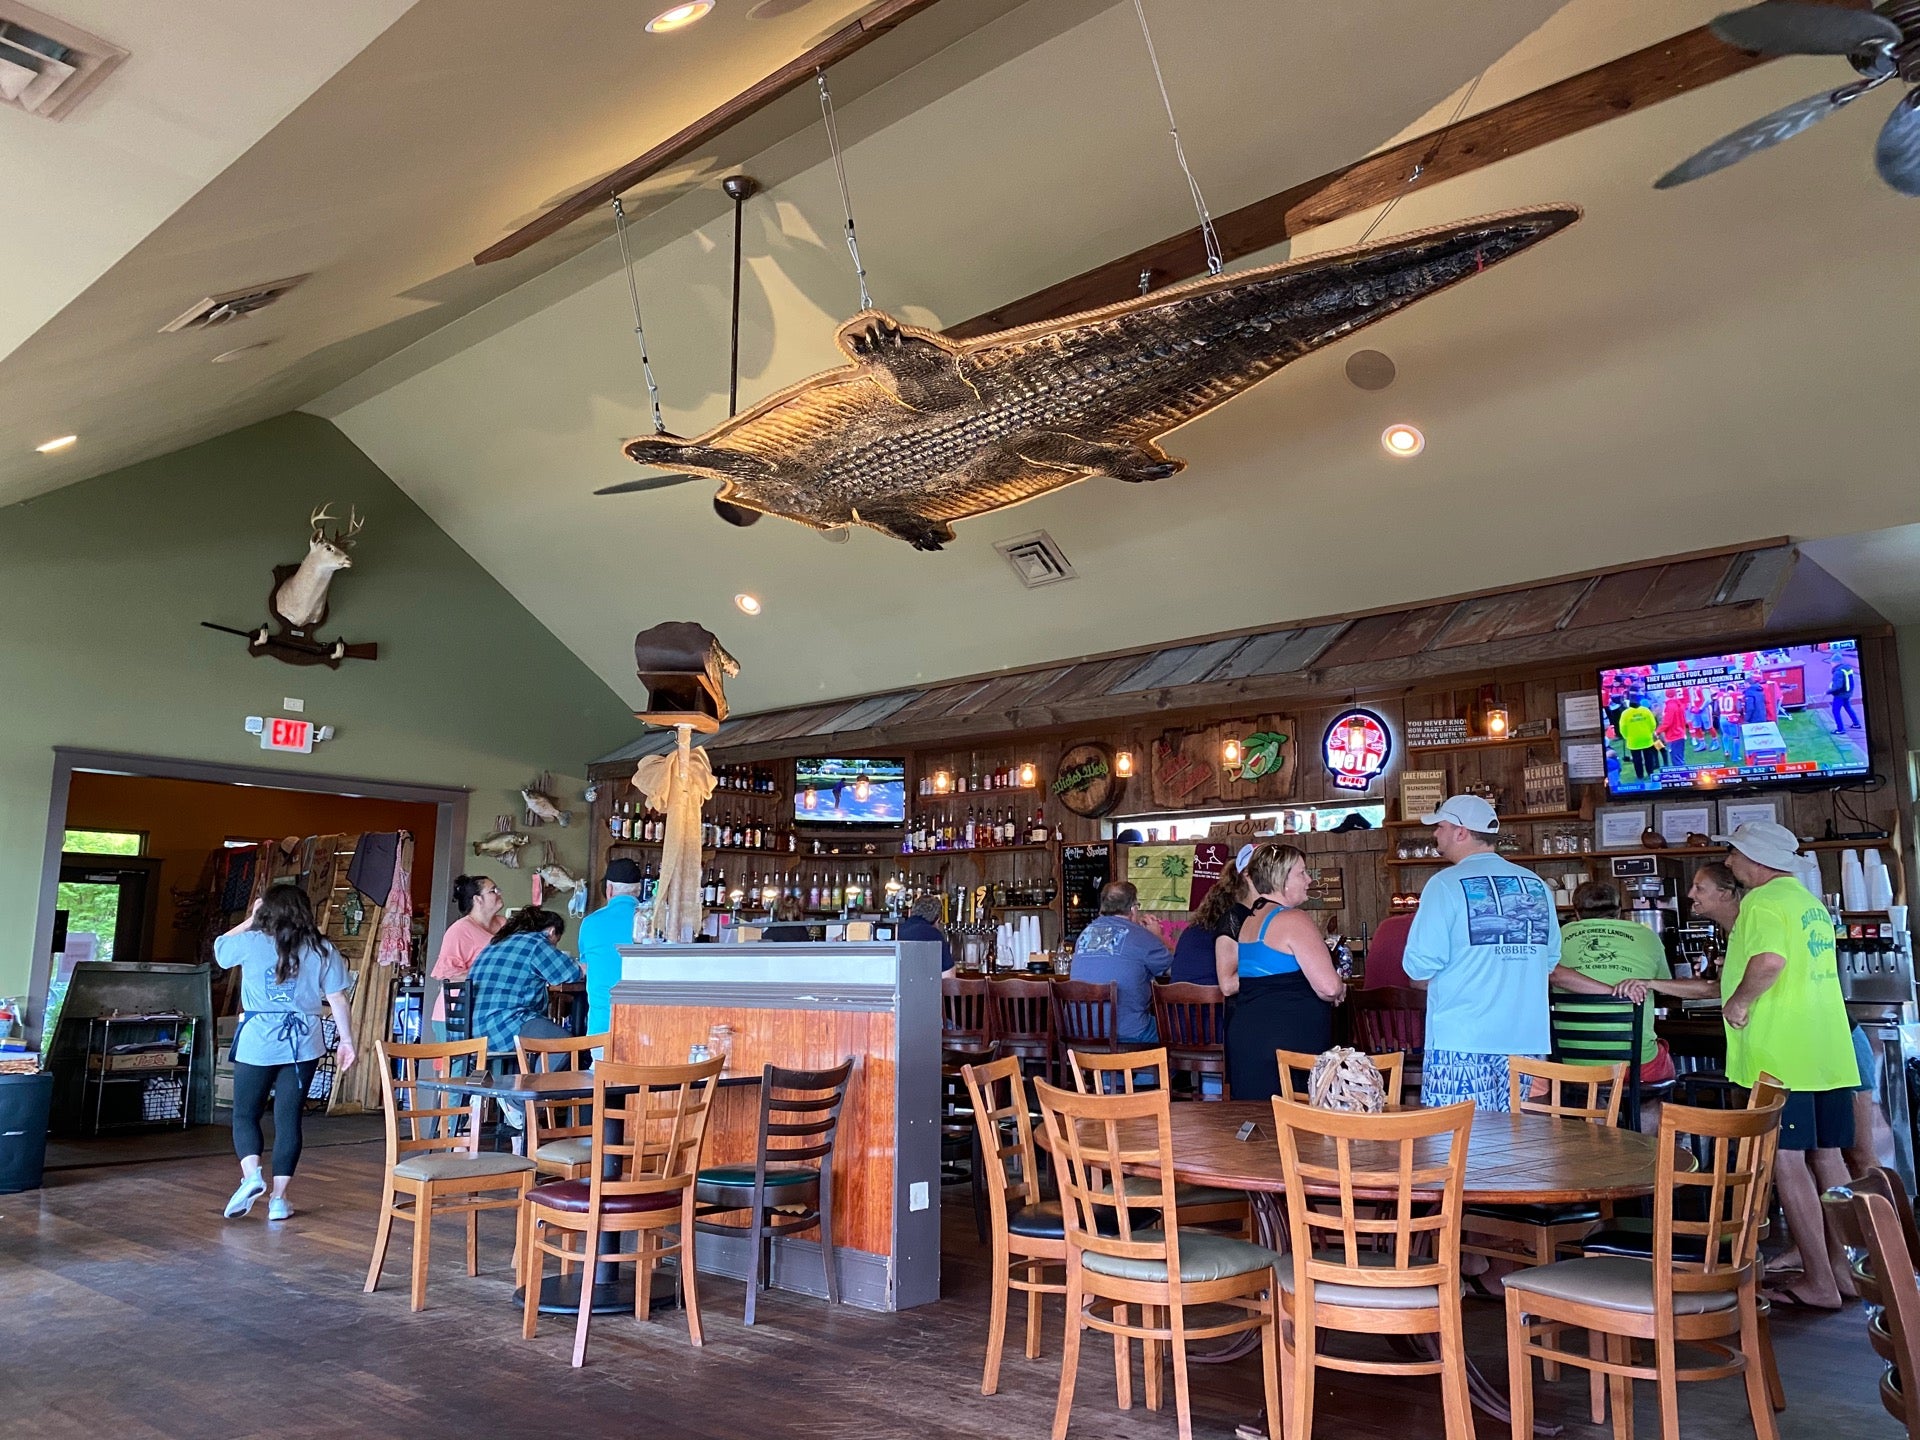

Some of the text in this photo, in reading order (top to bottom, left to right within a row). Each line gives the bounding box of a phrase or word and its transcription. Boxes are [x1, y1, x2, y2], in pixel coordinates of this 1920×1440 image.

[1646, 675, 1660, 683] THEY
[1702, 669, 1713, 677] DID
[1714, 667, 1725, 675] HIS
[1709, 675, 1734, 683] LOOKING
[1407, 720, 1422, 728] YOU
[1424, 719, 1447, 727] NEVER
[272, 718, 308, 749] EXIT
[1328, 749, 1355, 770] We
[1416, 771, 1443, 779] FORECAST
[1524, 764, 1564, 780] MEMORIES
[1525, 776, 1565, 790] MADE AT THE
[1526, 787, 1566, 806] LAKE
[1210, 821, 1268, 838] WELCOME
[1564, 928, 1636, 944] POPLAR CREEK LANDING
[1494, 945, 1537, 955] ROBBIE'S
